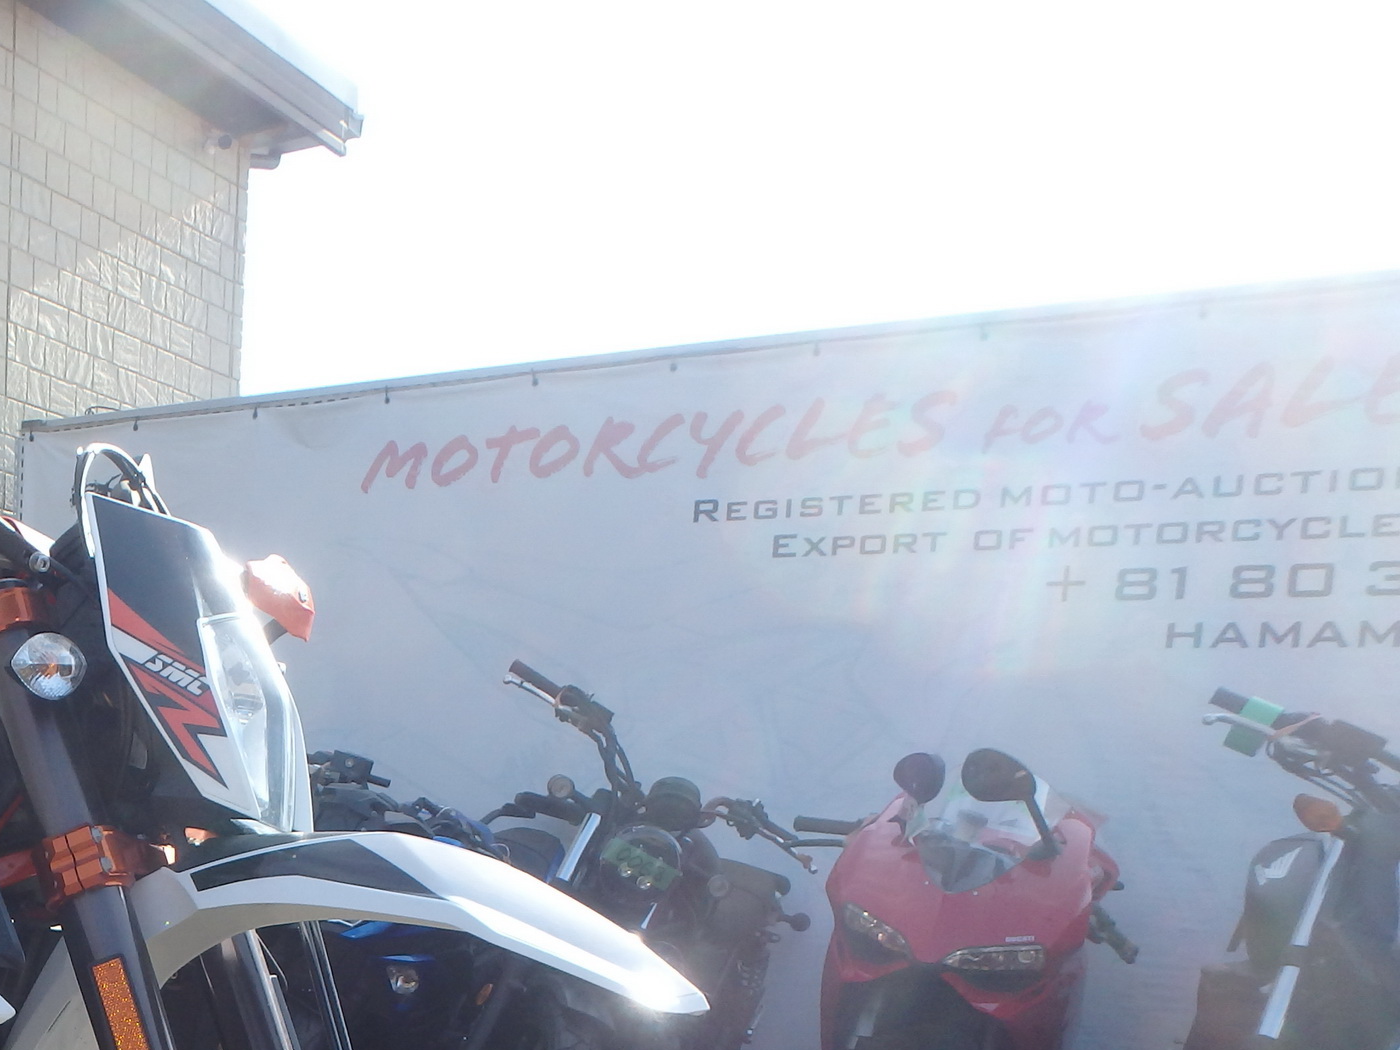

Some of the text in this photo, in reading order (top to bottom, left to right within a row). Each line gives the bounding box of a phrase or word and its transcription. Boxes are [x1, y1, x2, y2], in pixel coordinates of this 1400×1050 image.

[360, 389, 959, 495] MOTORCYCLES
[692, 467, 1400, 524] REGISTERED MOTO-AUCTIO
[771, 531, 946, 559] EXPORT
[972, 527, 1034, 551] OF
[1046, 565, 1086, 602] +
[1114, 566, 1189, 601] 81
[1229, 562, 1336, 598] 80
[1164, 620, 1400, 650] HAMAM
[144, 654, 210, 696] SMC
